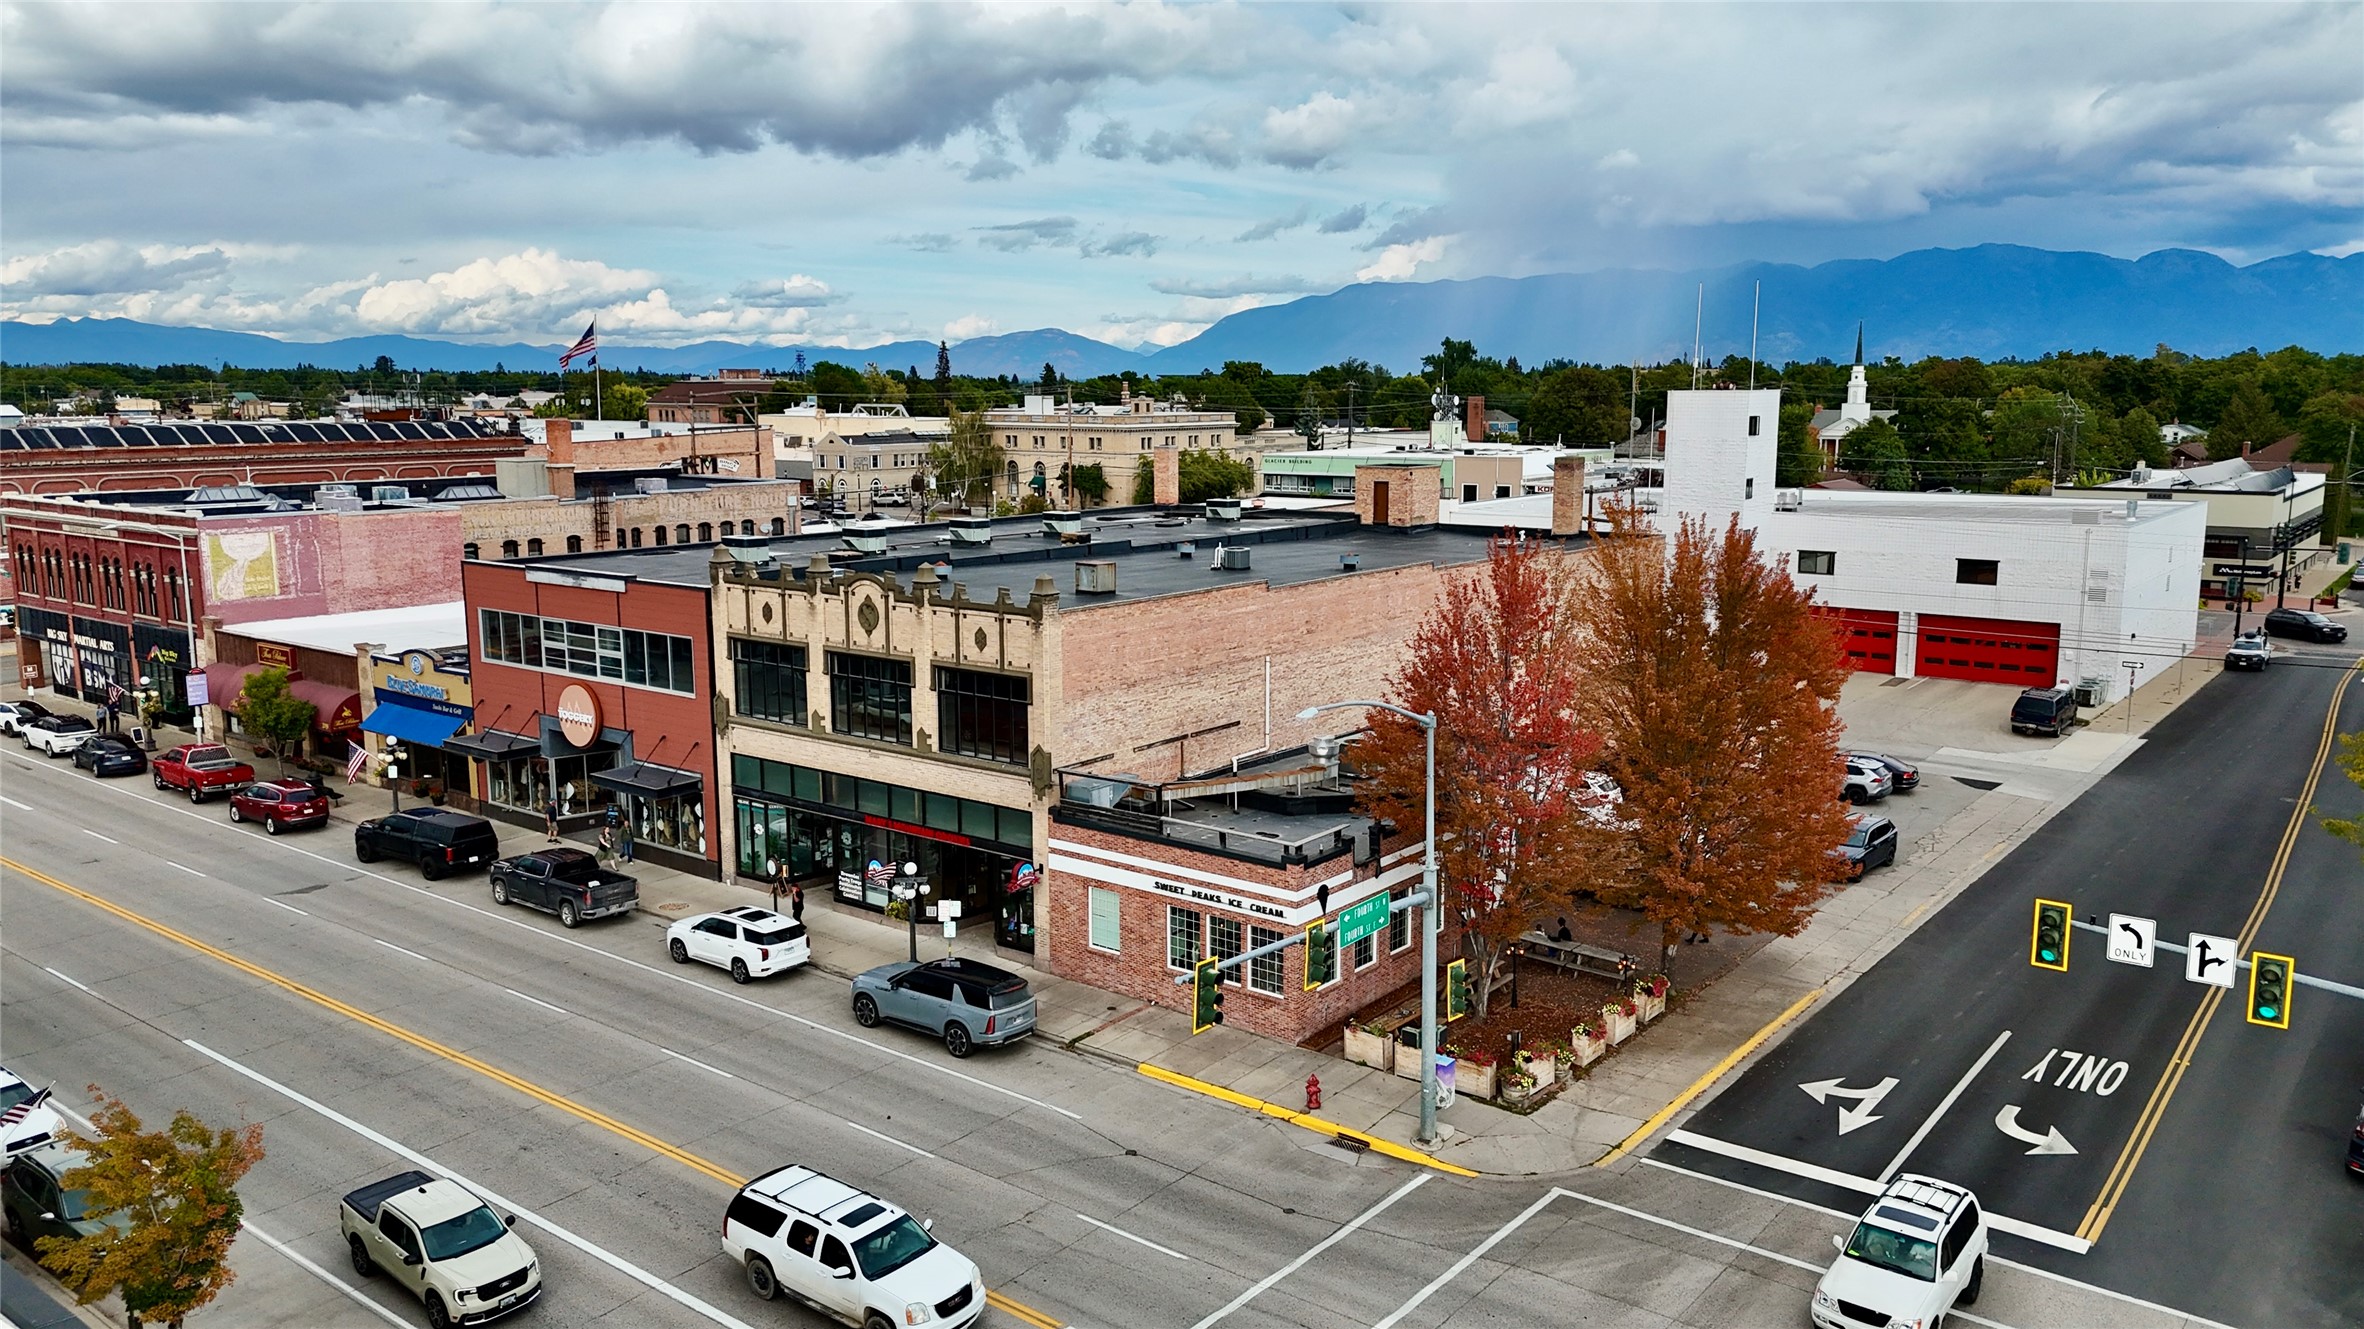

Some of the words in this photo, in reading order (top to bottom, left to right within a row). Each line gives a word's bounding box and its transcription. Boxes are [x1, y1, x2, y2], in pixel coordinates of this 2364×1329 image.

[46, 628, 57, 640] BIG
[56, 631, 68, 642] SKY
[73, 634, 98, 649] MARTIAL
[99, 639, 115, 652] ARTS
[1154, 881, 1185, 895] SWEET
[1191, 890, 1222, 903] PEAKS
[1228, 898, 1243, 908] ICE
[1250, 903, 1284, 918] CREAM
[1354, 903, 1374, 920] FOURTH
[1344, 925, 1364, 943] FOURTH
[2114, 948, 2147, 962] ONLY
[2021, 1048, 2130, 1097] ONLY
